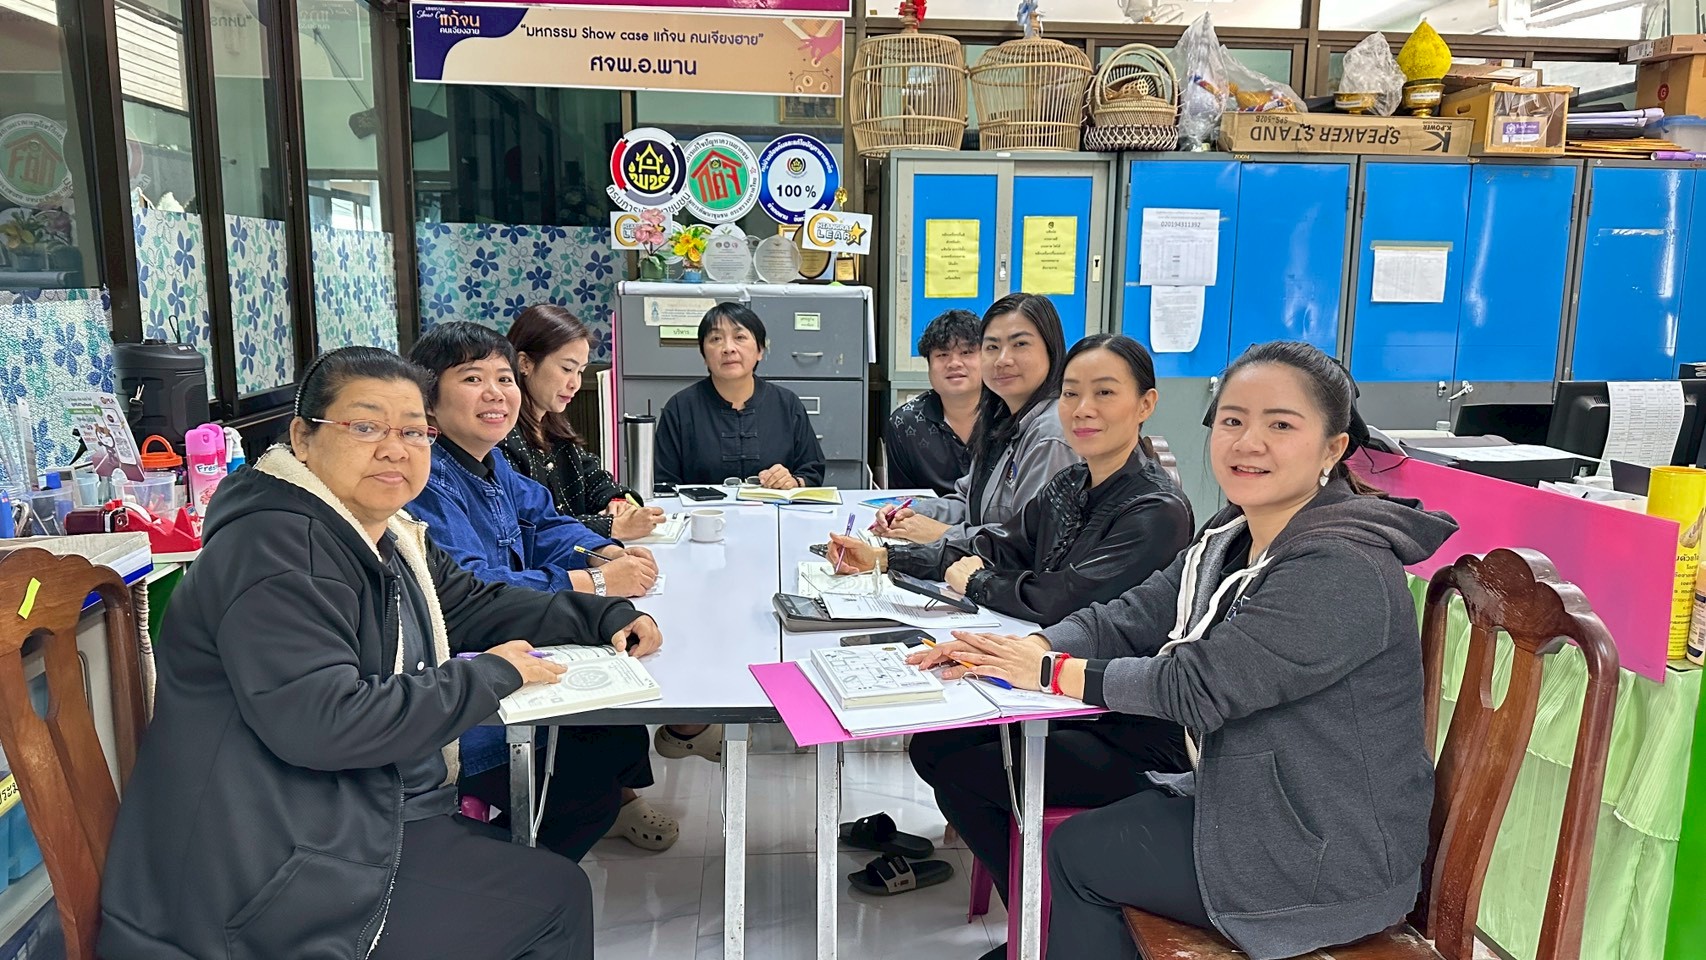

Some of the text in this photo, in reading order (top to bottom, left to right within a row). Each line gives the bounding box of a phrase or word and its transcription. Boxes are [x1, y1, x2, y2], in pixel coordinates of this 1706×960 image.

[440, 10, 480, 27] แก้จน
[520, 24, 577, 38] “มหกรรม
[582, 27, 616, 40] Show
[620, 32, 649, 42] case
[653, 28, 686, 43] แก้จน
[590, 55, 698, 76] ศจพ.อ.พาน
[1250, 125, 1402, 145] SPEAKER STAND
[776, 184, 817, 198] 100 %
